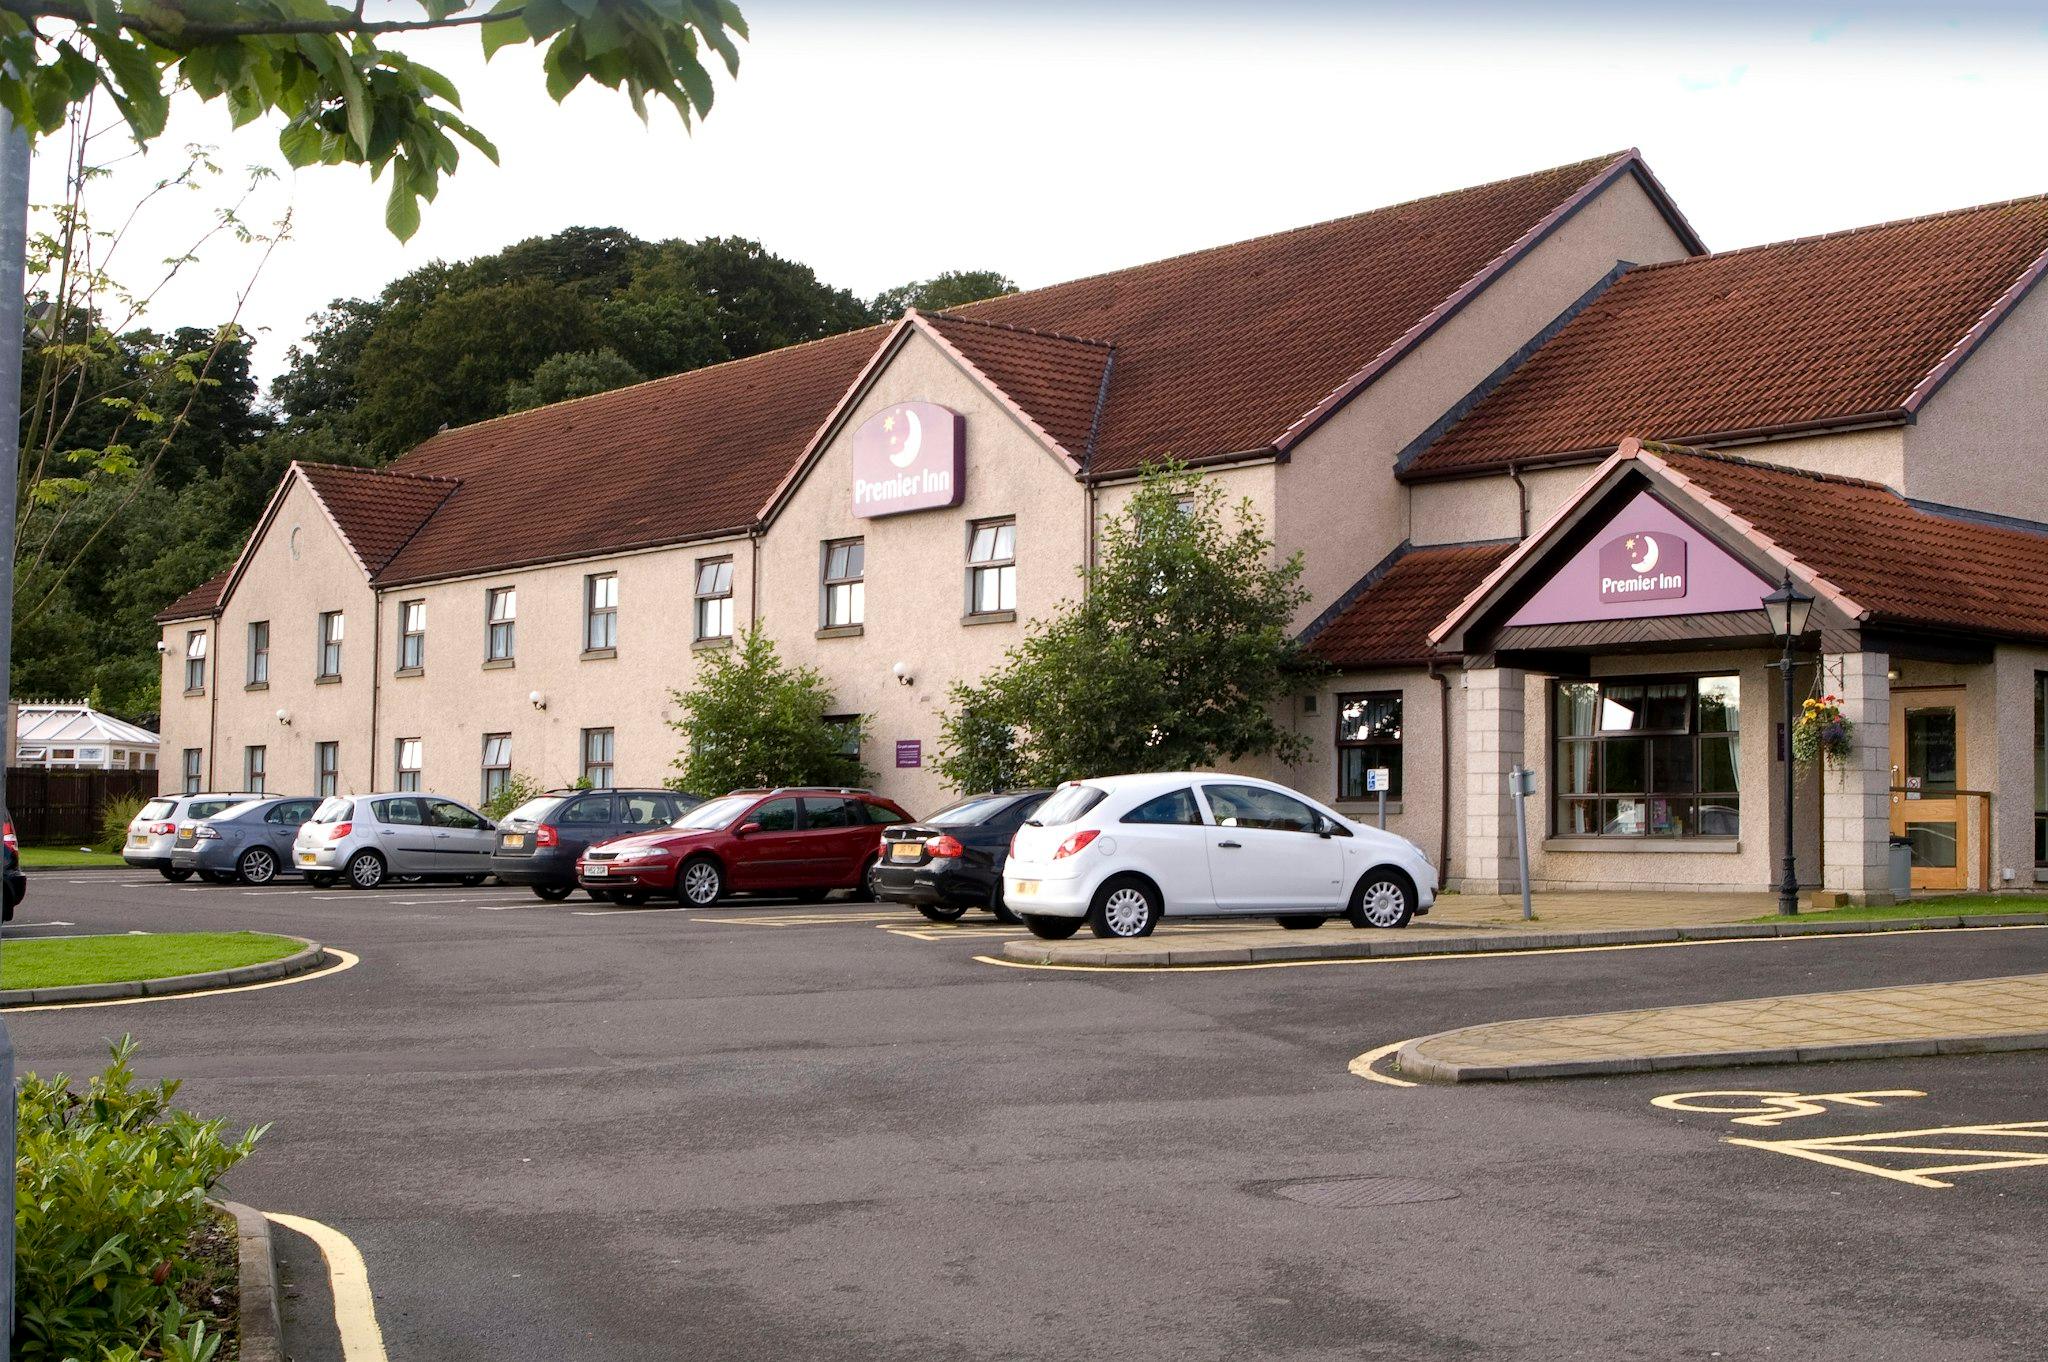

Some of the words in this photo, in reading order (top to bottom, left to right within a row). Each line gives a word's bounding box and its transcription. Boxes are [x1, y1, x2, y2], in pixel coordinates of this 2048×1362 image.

[855, 473, 920, 504] Premier
[922, 468, 949, 493] Inn
[1602, 575, 1657, 594] Premier
[1659, 572, 1682, 589] Inn
